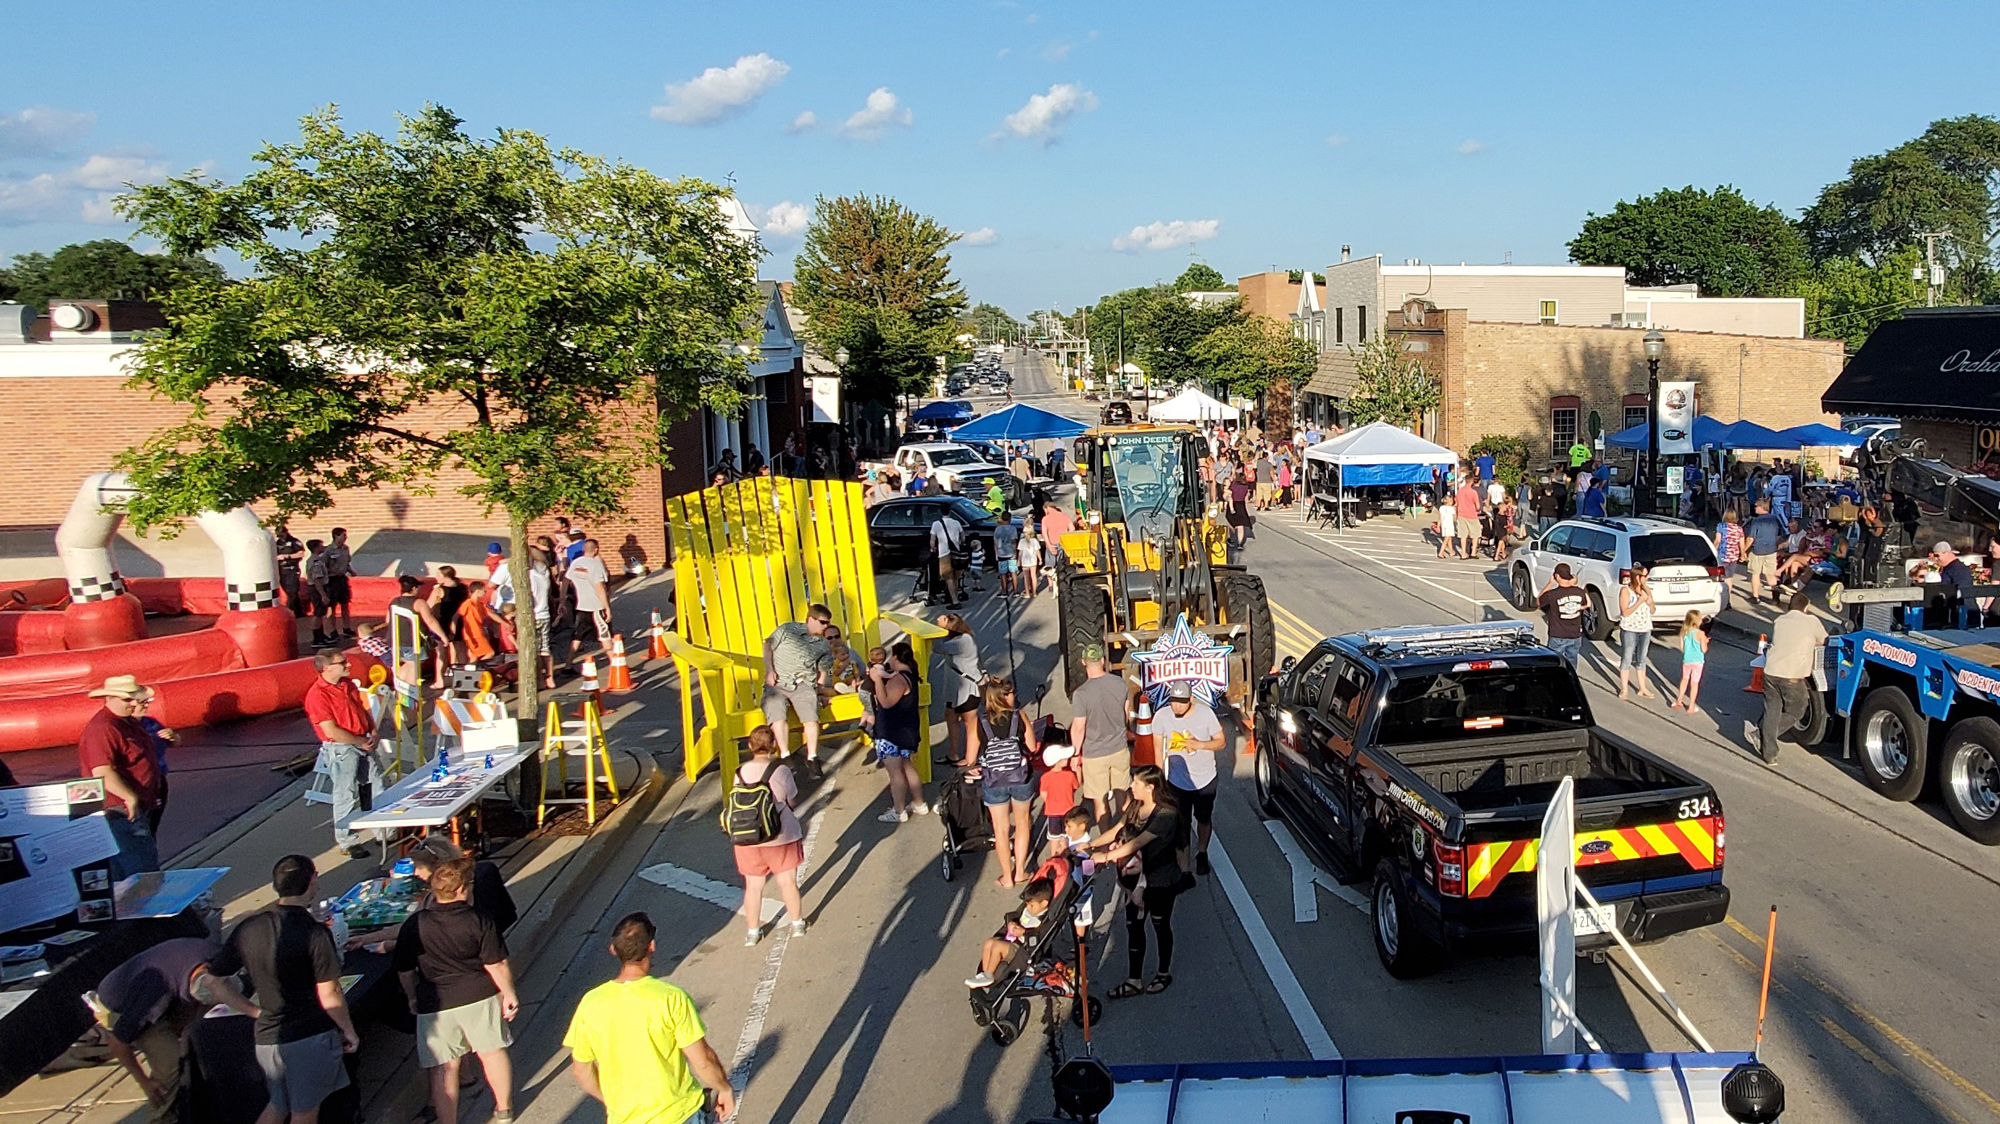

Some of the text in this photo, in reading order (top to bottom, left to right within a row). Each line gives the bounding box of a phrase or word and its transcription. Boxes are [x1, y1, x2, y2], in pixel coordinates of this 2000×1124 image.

[1117, 435, 1173, 445] JOHN DEERE
[1880, 643, 1917, 668] TOWING
[1147, 661, 1221, 682] NIGHT OUT
[1958, 669, 1994, 693] INCIDENT
[1678, 796, 1711, 819] 534
